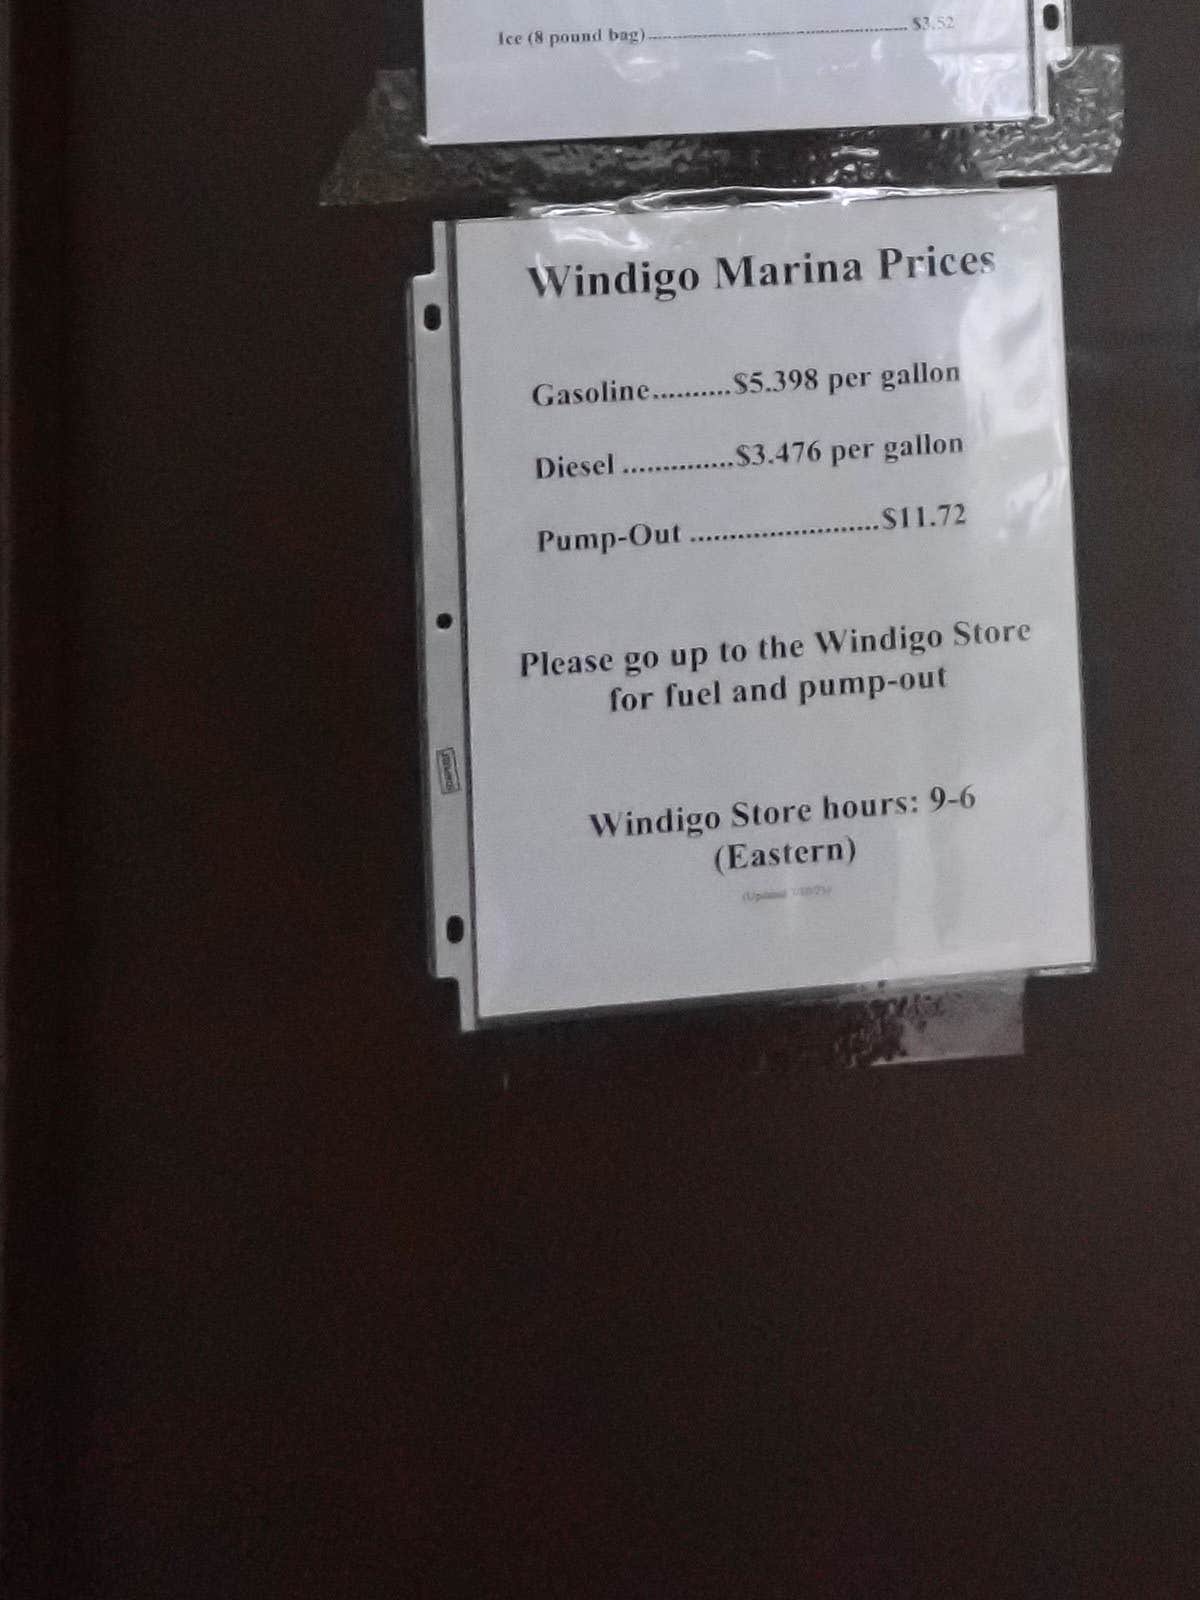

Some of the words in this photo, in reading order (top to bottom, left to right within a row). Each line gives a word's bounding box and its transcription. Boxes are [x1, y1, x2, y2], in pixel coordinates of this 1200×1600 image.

[498, 31, 522, 45] Ice
[528, 30, 543, 45] (8
[550, 29, 602, 47] pound
[609, 28, 645, 44] bag)
[527, 261, 700, 302] Windigo
[715, 254, 864, 290] Marina
[878, 244, 996, 282] Prices
[828, 365, 871, 396] per
[880, 361, 961, 389] gallon
[535, 454, 615, 480] Diesel
[831, 436, 875, 467] per
[883, 433, 964, 461] gallon
[537, 523, 682, 553] Pump-Out
[519, 648, 613, 678] Please
[624, 648, 659, 677] go
[671, 645, 709, 673] up
[719, 640, 748, 664] to
[759, 635, 805, 660] the
[814, 625, 943, 657] Windigo
[952, 619, 1032, 647] Store
[610, 686, 654, 713] for
[666, 681, 721, 709] fuel
[731, 676, 788, 704] and
[798, 667, 948, 707] pump-out
[589, 806, 721, 838] Windigo
[731, 801, 812, 828] Store
[823, 793, 918, 822] hours:
[929, 784, 977, 812] 9-6
[713, 837, 857, 876] (Eastern)
